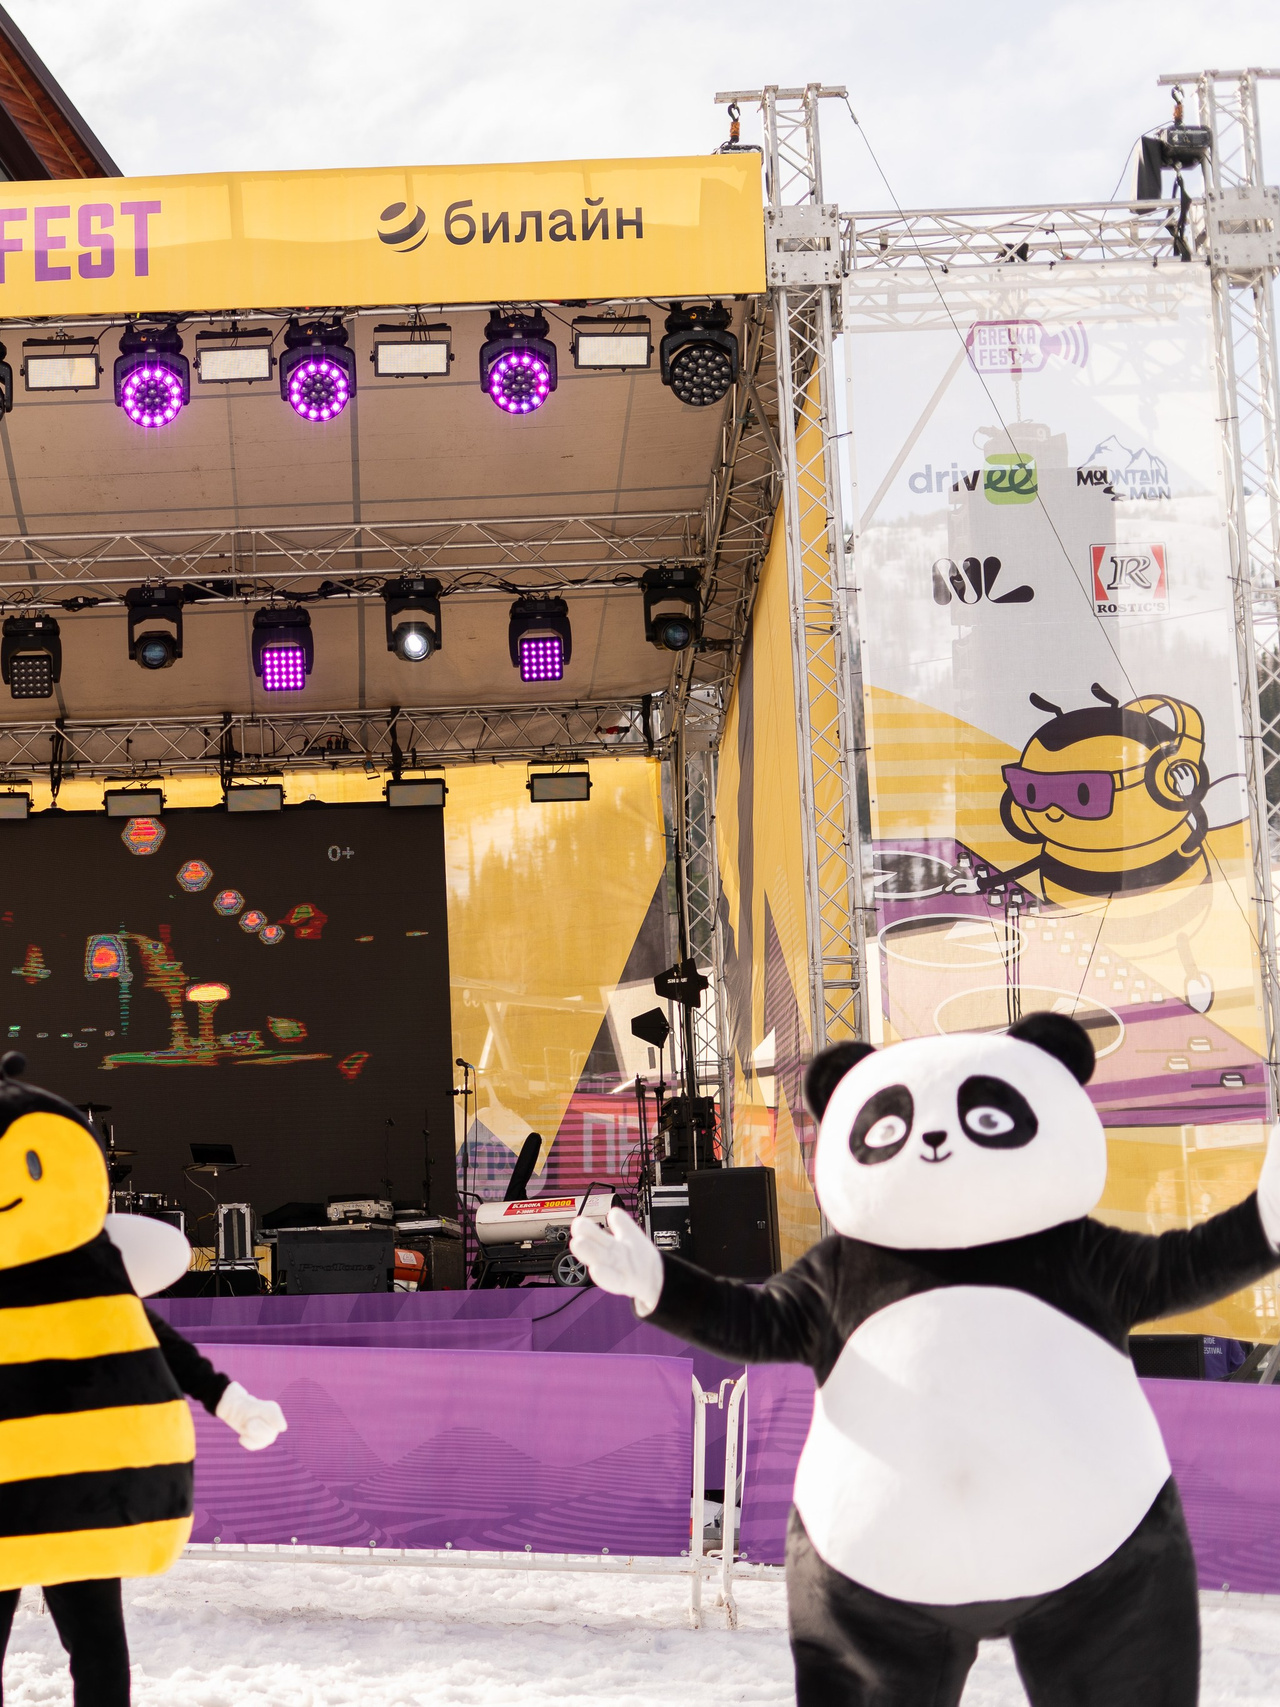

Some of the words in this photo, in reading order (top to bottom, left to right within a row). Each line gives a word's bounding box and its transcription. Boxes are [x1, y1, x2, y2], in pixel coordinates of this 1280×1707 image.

[443, 196, 644, 246] билайн
[978, 327, 1036, 346] GRELKA
[979, 347, 1018, 366] FEST
[908, 462, 1039, 495] drivee
[1076, 469, 1169, 486] MOUNTAIN
[1130, 486, 1172, 500] MAN
[1096, 602, 1166, 613] ROSTIC'S
[327, 845, 355, 862] 0+
[543, 1199, 572, 1208] 30000
[1203, 1346, 1223, 1355] ESTIVAL
